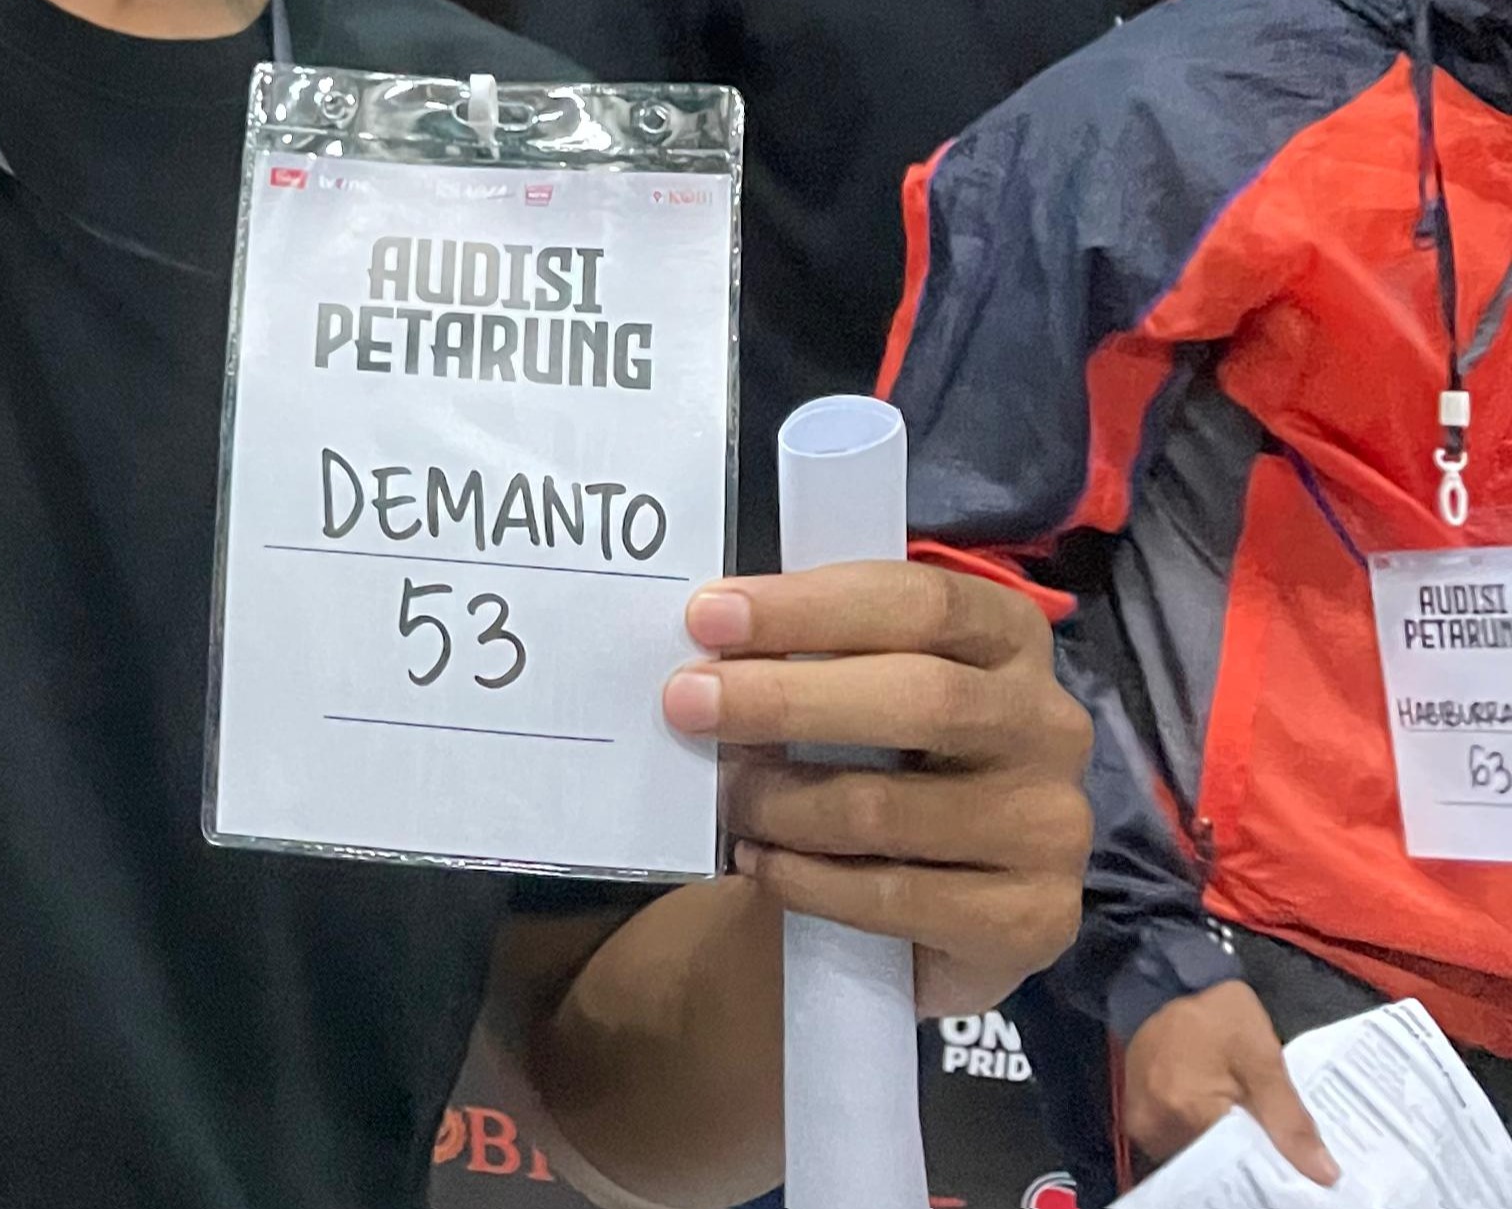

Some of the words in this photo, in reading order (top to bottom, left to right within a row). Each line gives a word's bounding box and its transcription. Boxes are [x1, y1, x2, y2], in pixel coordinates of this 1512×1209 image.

[368, 236, 604, 314] AUDISI
[314, 303, 653, 391] PETARUNG
[321, 447, 667, 561] DEMANTO
[1419, 584, 1508, 616] AUDISI
[398, 577, 527, 690] 53
[1404, 618, 1512, 649] PETARUN
[1469, 744, 1512, 794] 63
[942, 1044, 1034, 1083] PRID
